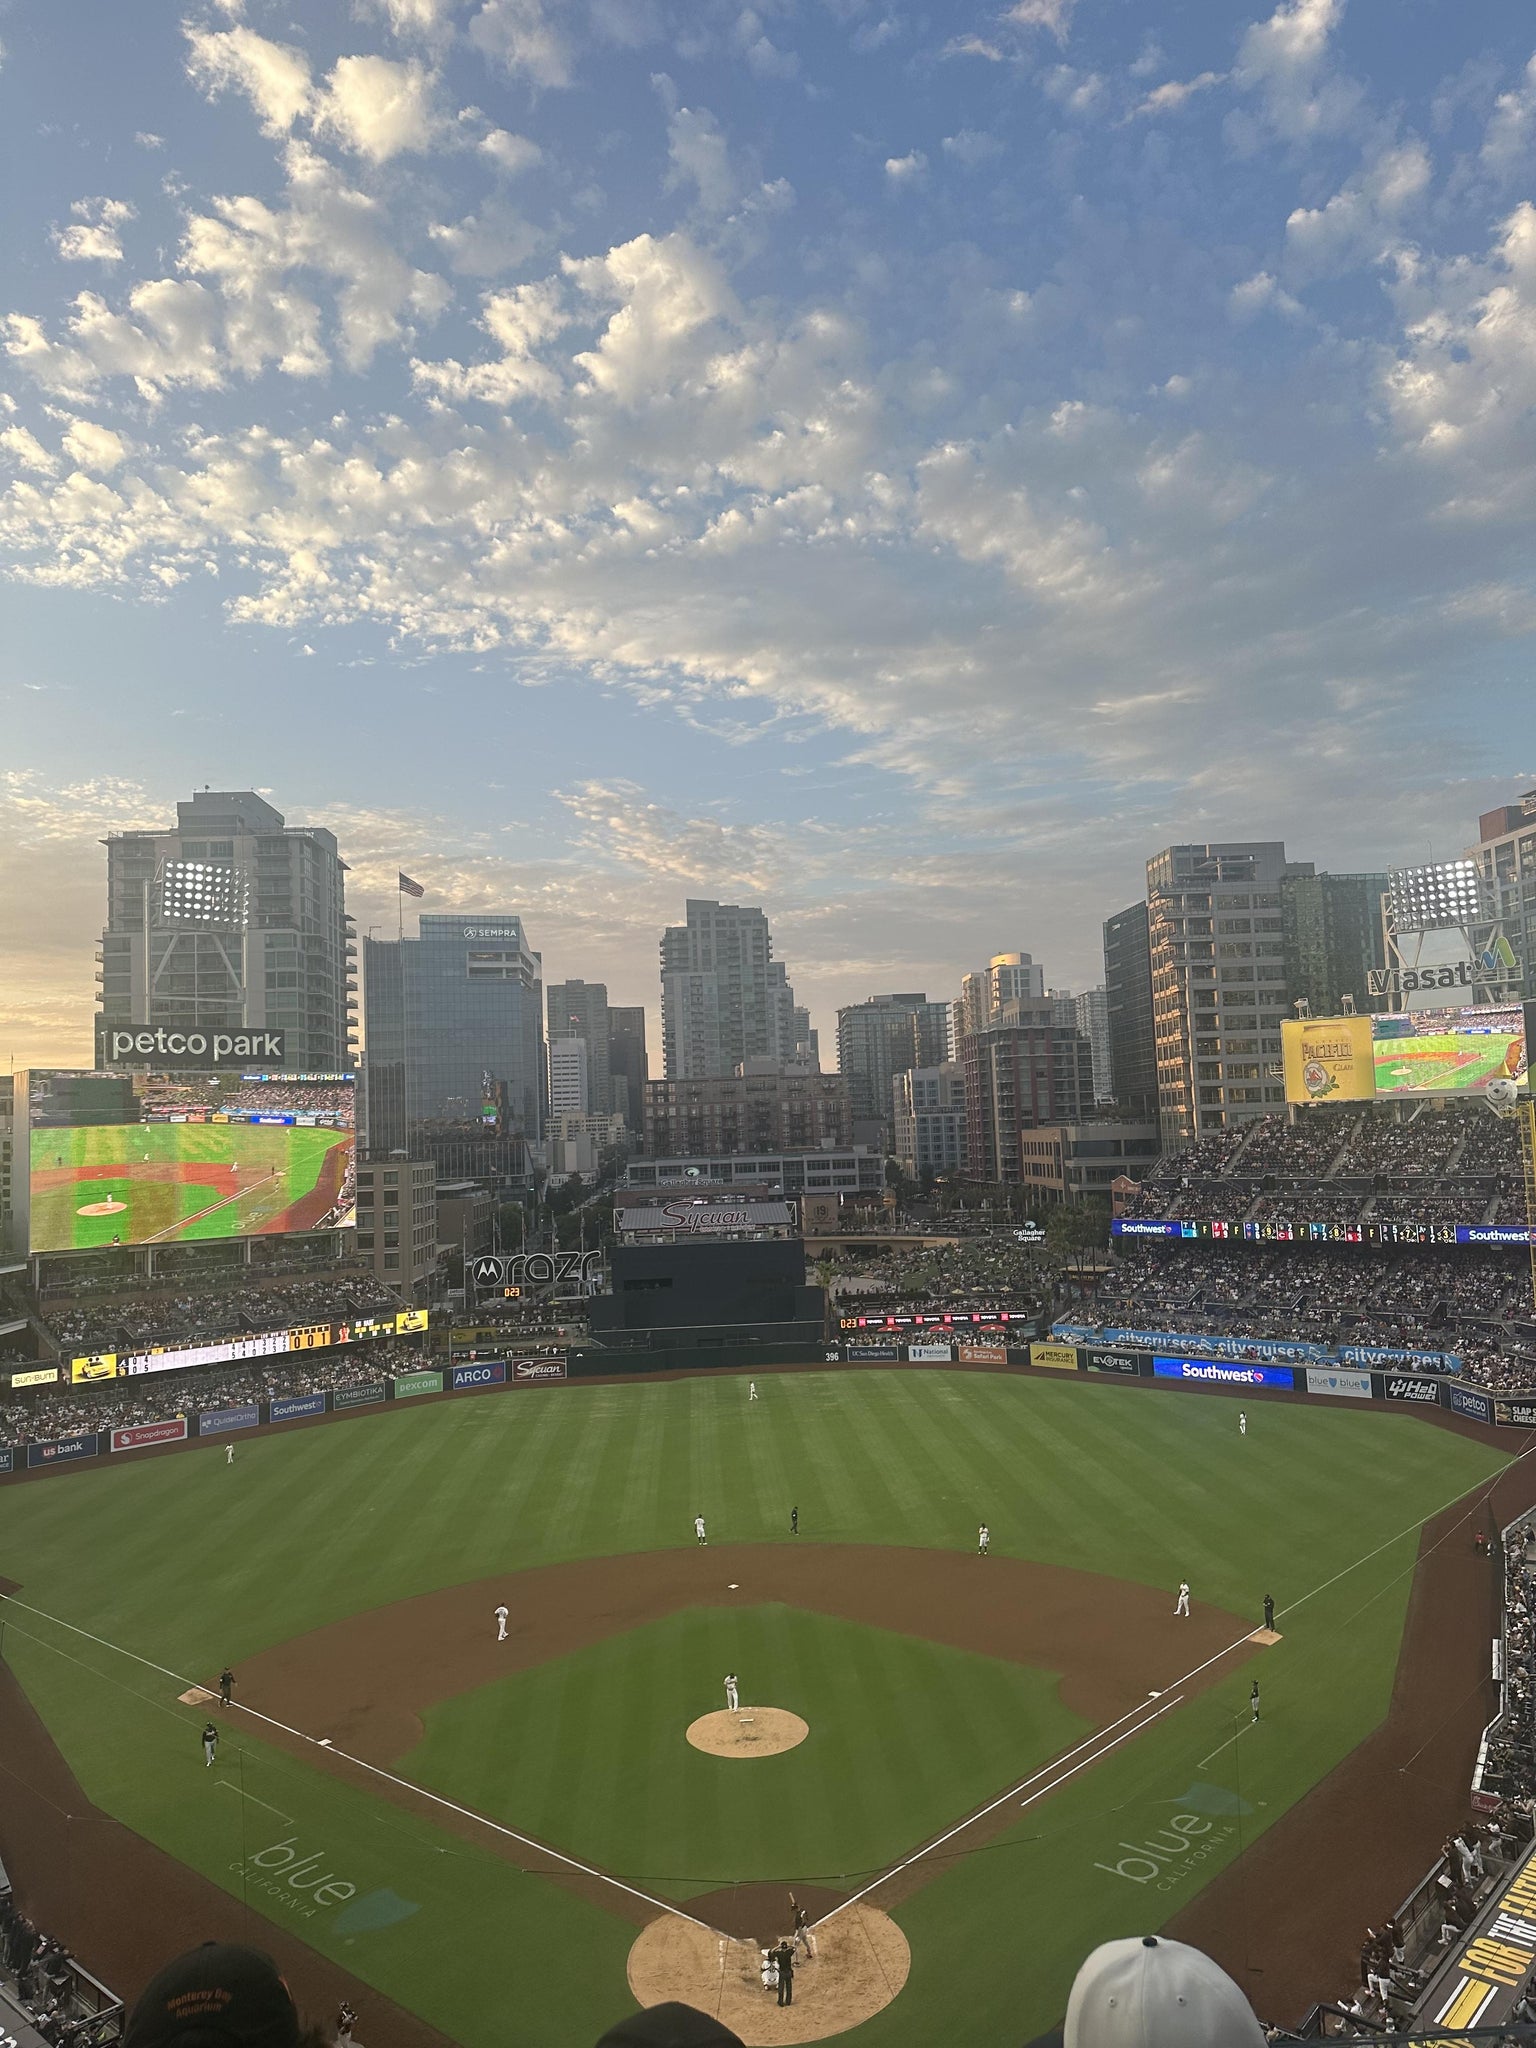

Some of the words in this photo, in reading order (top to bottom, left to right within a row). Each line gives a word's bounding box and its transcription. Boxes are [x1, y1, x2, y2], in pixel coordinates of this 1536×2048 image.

[478, 928, 517, 938] SEMPRA
[1370, 961, 1474, 994] Viasat
[112, 1027, 208, 1061] petco
[213, 1033, 282, 1062] park
[661, 1200, 752, 1233] Sycuan
[816, 1205, 827, 1216] 19
[1013, 1229, 1046, 1237] Gallagher
[1121, 1223, 1166, 1234] Southwest
[1191, 1221, 1197, 1229] 4
[1202, 1225, 1208, 1234] F
[1221, 1222, 1229, 1231] 14
[1234, 1226, 1239, 1235] F
[1254, 1222, 1260, 1231] 9
[1287, 1223, 1293, 1232] 2
[1300, 1227, 1305, 1236] F
[1321, 1224, 1327, 1232] 7
[1356, 1224, 1362, 1233] 4
[1369, 1228, 1375, 1238] F
[1392, 1225, 1398, 1234] 5
[1429, 1225, 1434, 1235] 1
[1223, 1230, 1229, 1239] 9
[1255, 1231, 1261, 1240] 6
[1288, 1231, 1294, 1240] 0
[1322, 1232, 1328, 1241] 2
[1357, 1233, 1363, 1242] 3
[1393, 1233, 1398, 1243] 1
[1405, 1229, 1411, 1239] 7
[1429, 1234, 1436, 1243] 2
[1443, 1229, 1449, 1239] 3
[1468, 1229, 1530, 1241] Southwest
[1017, 1235, 1042, 1243] Square
[506, 1250, 601, 1286] razr
[504, 1287, 520, 1297] 0:23
[840, 1318, 857, 1329] 0:23
[294, 1336, 301, 1349] 0
[307, 1334, 314, 1347] 0
[322, 1332, 327, 1345] 1
[825, 1352, 840, 1362] 396
[1045, 1351, 1074, 1359] MERCURY
[1093, 1355, 1133, 1367] EVOTEK
[455, 1369, 491, 1385] ARCO
[517, 1361, 561, 1378] Sycuan
[1182, 1363, 1255, 1383] Southwest
[1308, 1375, 1329, 1386] blue
[1339, 1378, 1360, 1388] blue
[1404, 1392, 1436, 1401] POWER
[1462, 1395, 1486, 1412] petco
[273, 1401, 317, 1416] Southwest
[1512, 1406, 1532, 1416] SLAP
[213, 1412, 256, 1426] QuidelOrtho
[135, 1427, 179, 1441] Snapdragon
[43, 1447, 56, 1457] us
[57, 1441, 83, 1454] bank
[1093, 1813, 1213, 1885] blue
[1157, 1825, 1237, 1892] CALIFORNIA
[248, 1837, 356, 1907] blue
[227, 1861, 316, 1919] CALIFORNIA
[1486, 1912, 1536, 1948] THE
[1458, 1937, 1536, 1987] FOR
[166, 1989, 214, 2011] Monterey
[176, 2001, 222, 2019] Aquarium
